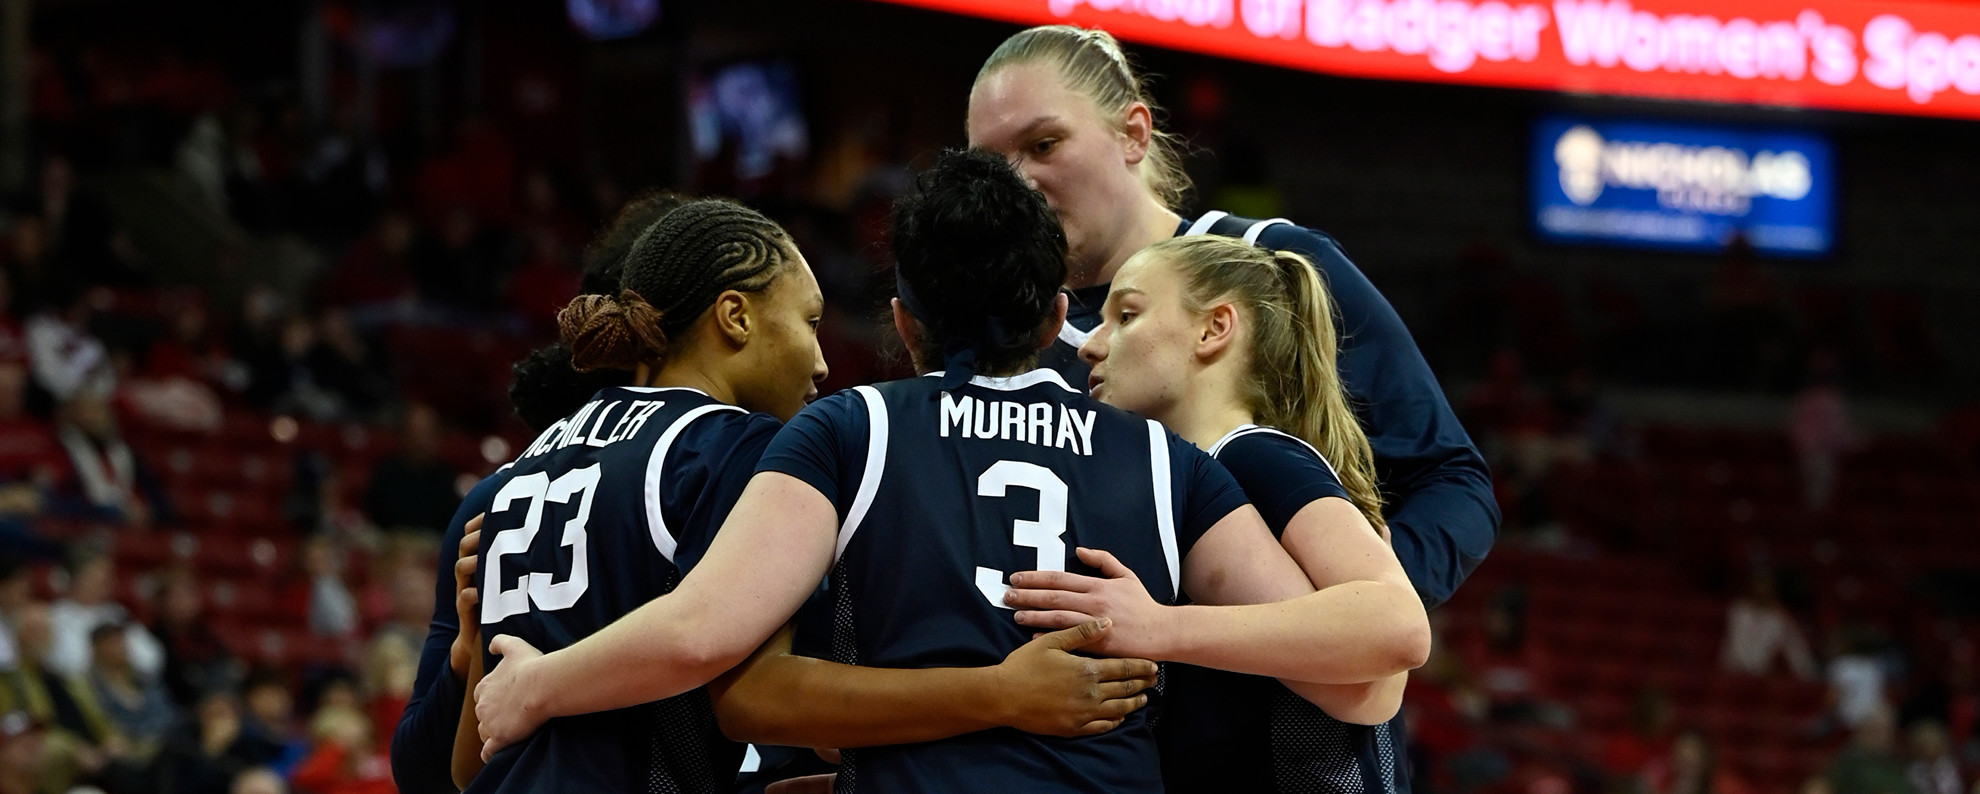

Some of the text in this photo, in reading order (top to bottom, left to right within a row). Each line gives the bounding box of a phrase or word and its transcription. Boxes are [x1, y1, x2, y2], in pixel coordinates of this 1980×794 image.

[1305, 0, 1550, 73] Badger
[1553, 0, 1857, 86] Women's
[939, 390, 1097, 456] MURRAY
[480, 462, 602, 625] 23
[974, 459, 1069, 611] 3
